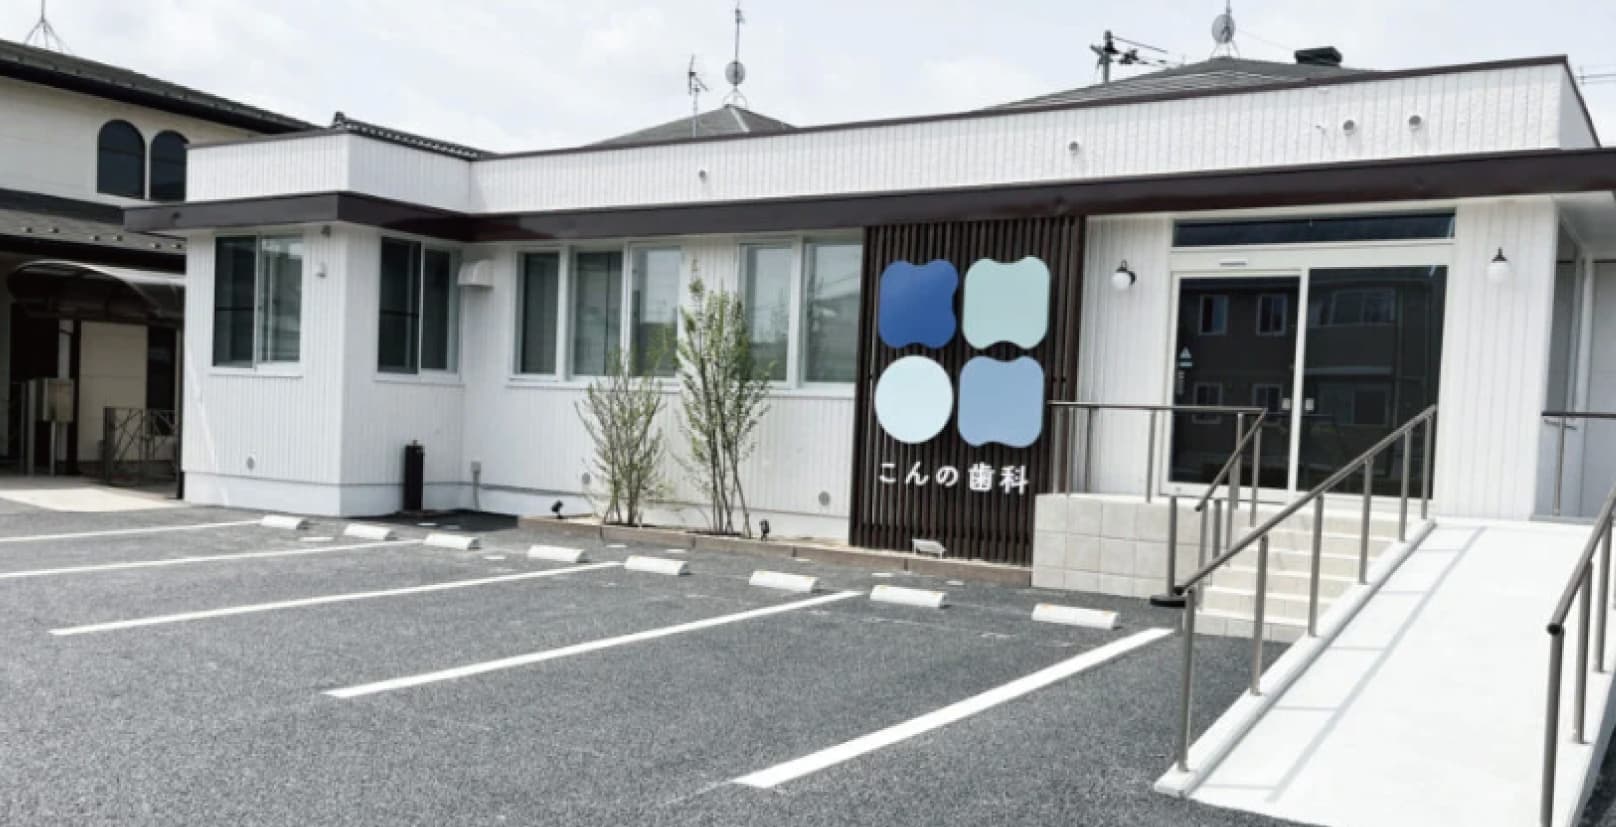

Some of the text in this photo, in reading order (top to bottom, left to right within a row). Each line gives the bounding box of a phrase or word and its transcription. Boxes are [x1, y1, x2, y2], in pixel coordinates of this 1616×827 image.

[879, 461, 1029, 495] こんの歯科
